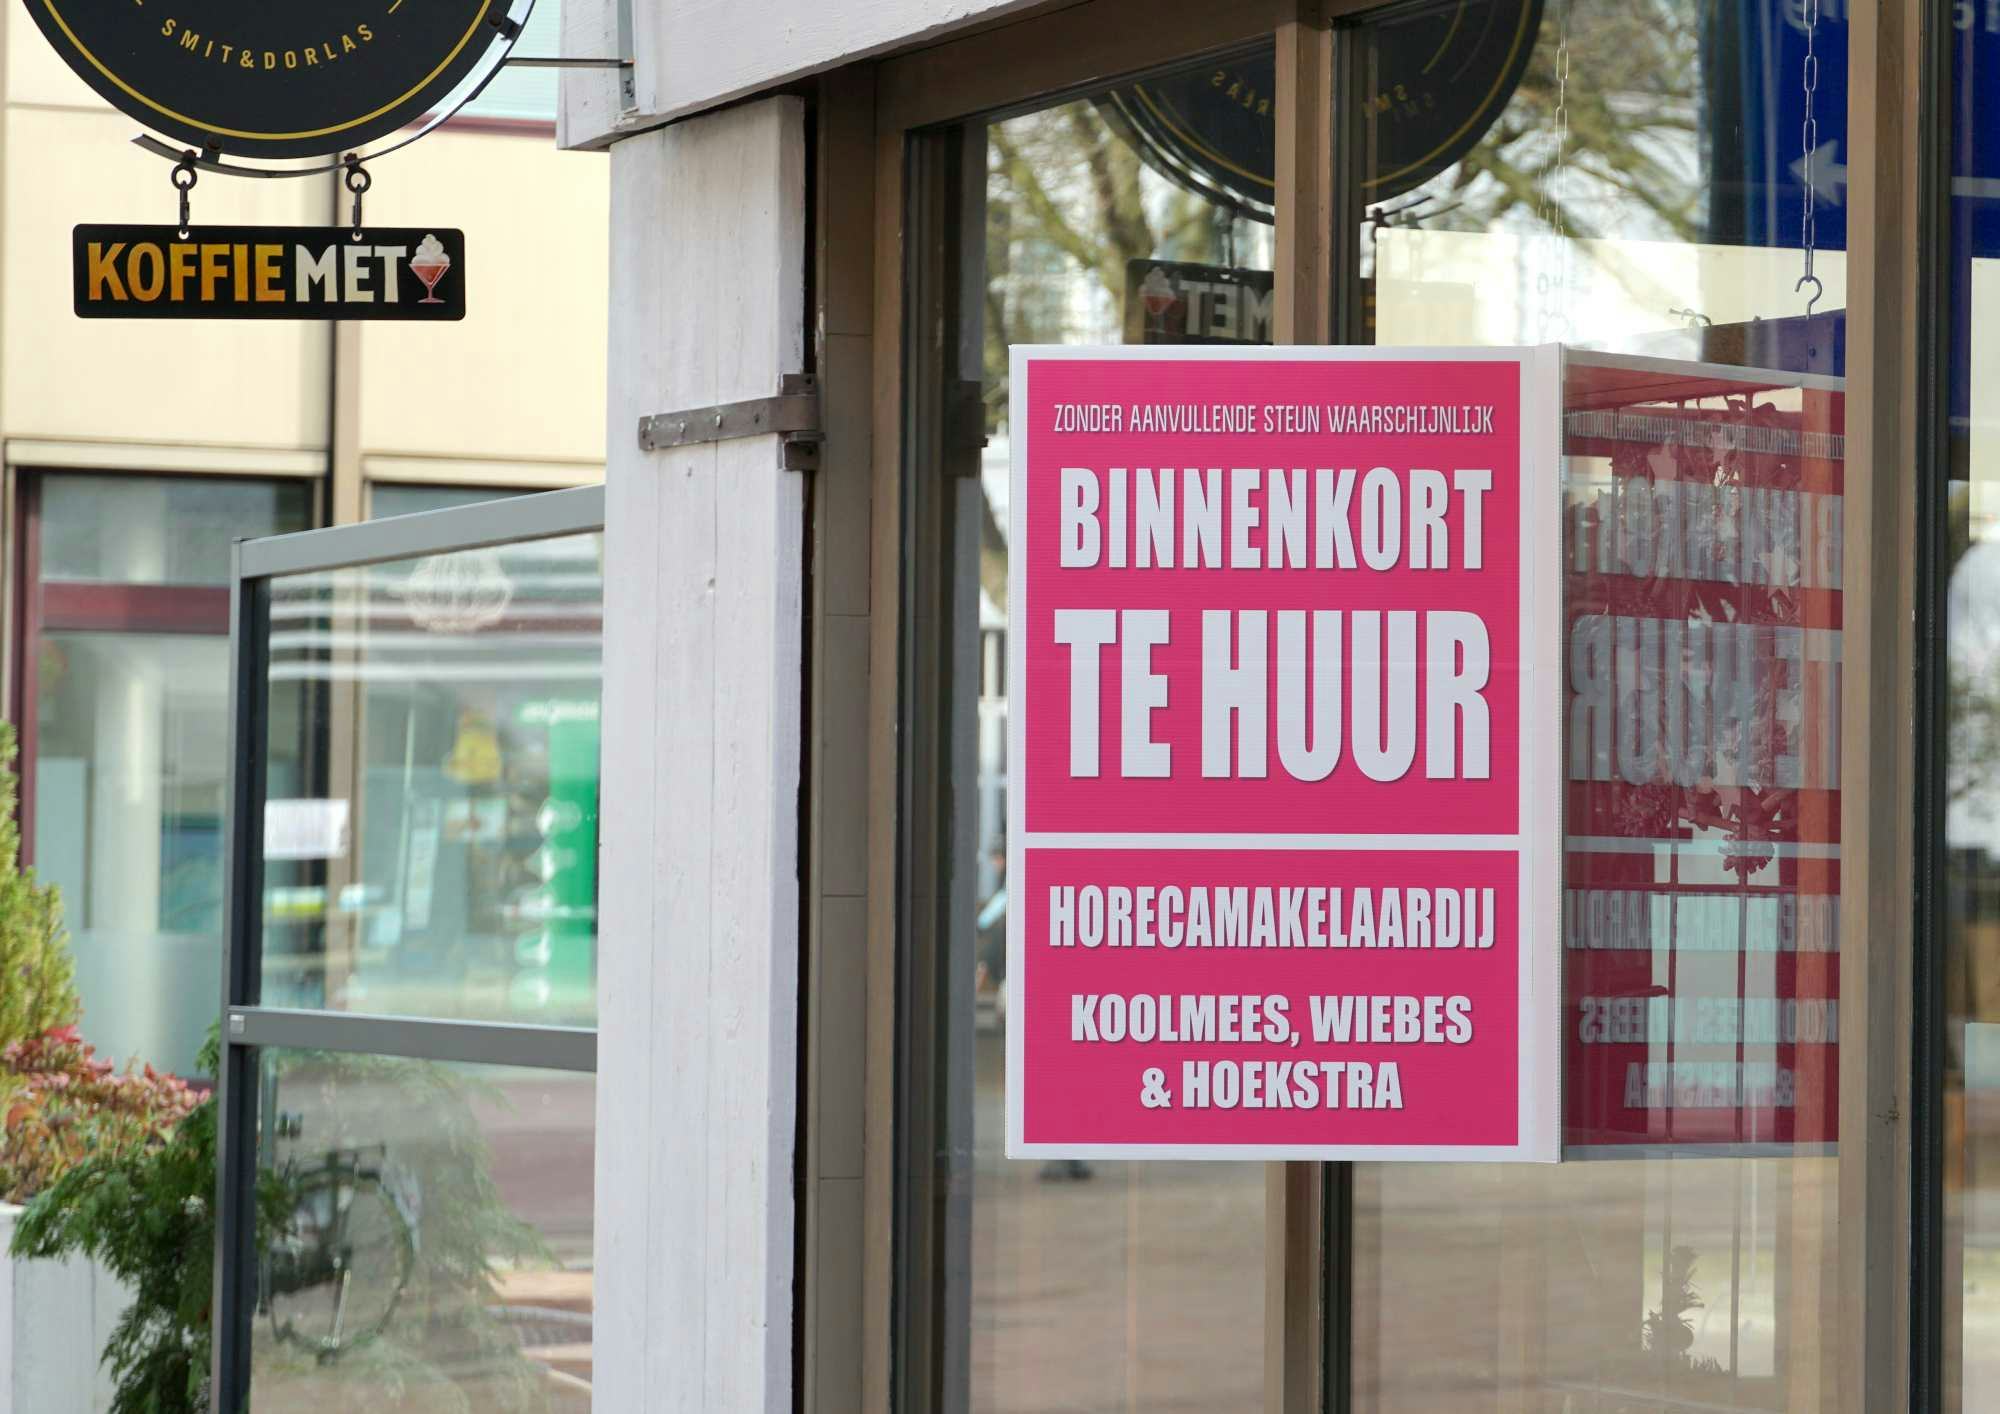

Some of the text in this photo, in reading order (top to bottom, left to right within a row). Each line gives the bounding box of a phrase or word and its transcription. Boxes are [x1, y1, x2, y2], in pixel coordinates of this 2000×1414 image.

[88, 242, 407, 303] KOFFIE MET
[1053, 403, 1494, 434] ZONDER AANVULLENDE STEUN WAARSCHIJNLIJK
[1059, 466, 1493, 571] BINNENKORT
[1053, 608, 1491, 782] TE HUUR
[1048, 884, 1495, 948] HORECAMAKELAARDIJ
[1070, 994, 1473, 1048] KOOLMEES, WIEBES
[1140, 1060, 1404, 1109] & HOEKSTRA
